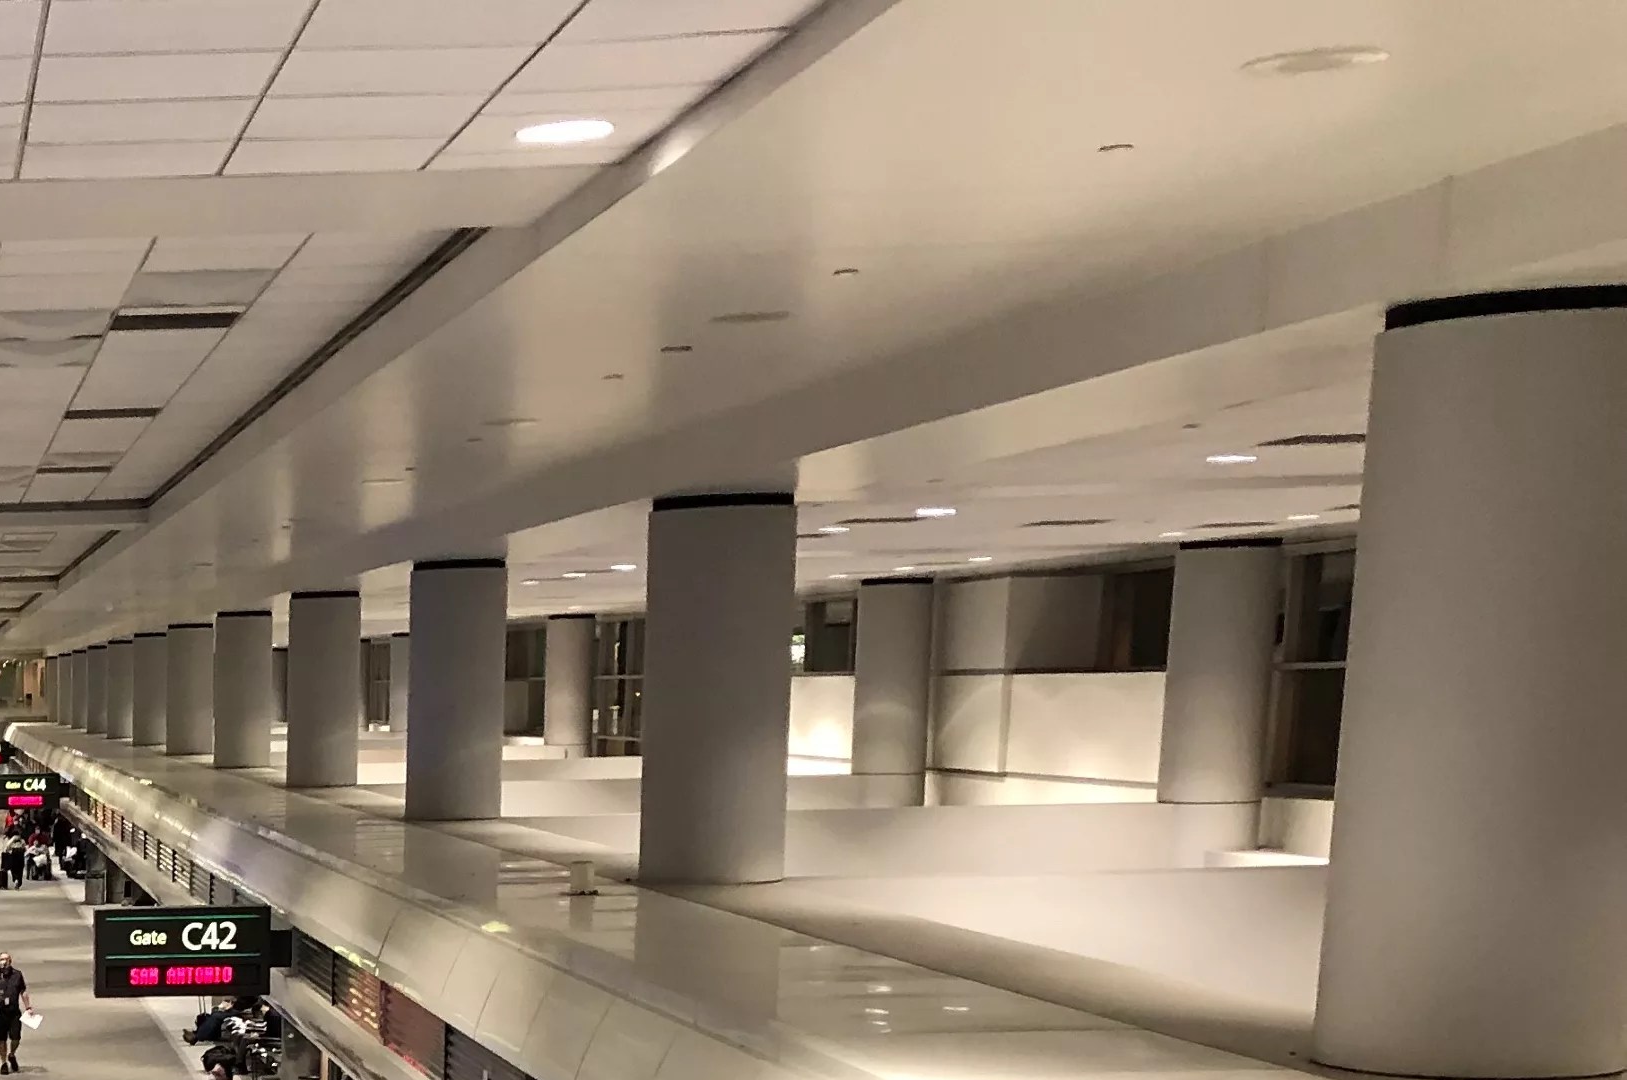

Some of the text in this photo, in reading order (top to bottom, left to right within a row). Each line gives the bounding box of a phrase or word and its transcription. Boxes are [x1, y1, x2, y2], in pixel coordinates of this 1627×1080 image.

[22, 777, 47, 792] C44
[129, 920, 237, 951] Gate C42
[129, 966, 233, 985] SAN ANTONIO
